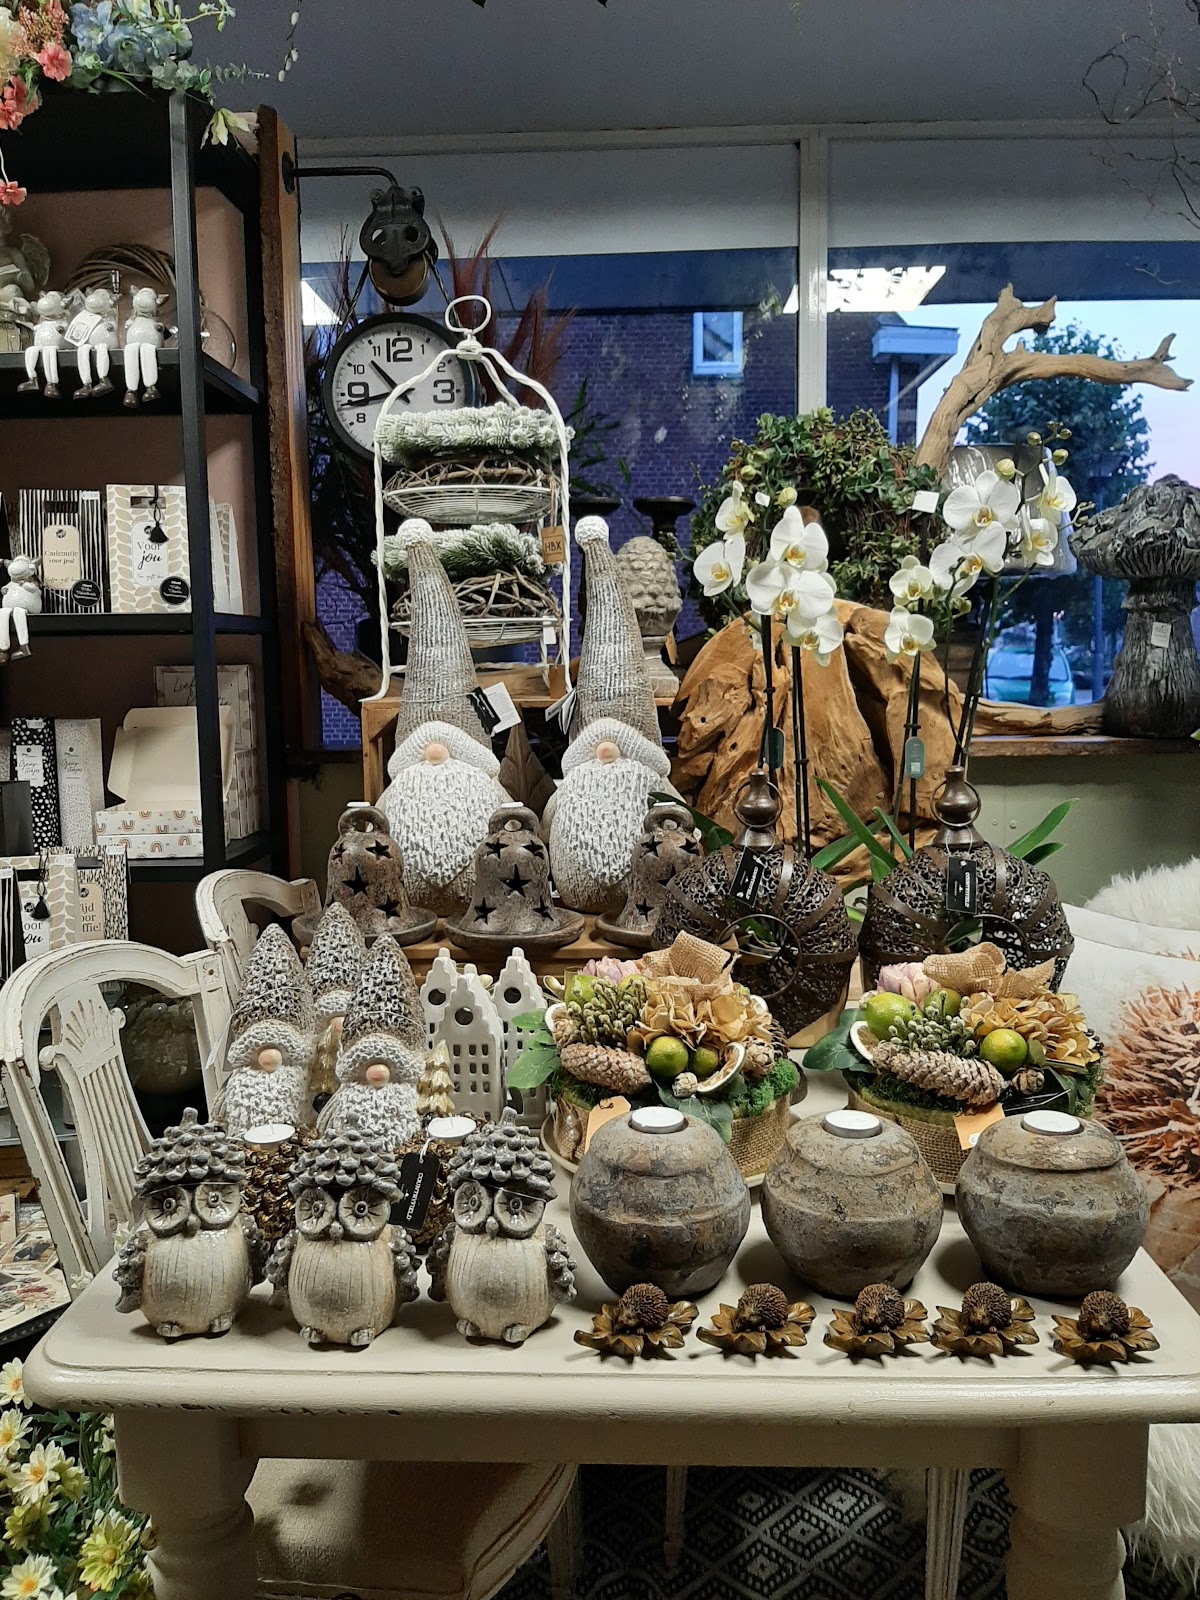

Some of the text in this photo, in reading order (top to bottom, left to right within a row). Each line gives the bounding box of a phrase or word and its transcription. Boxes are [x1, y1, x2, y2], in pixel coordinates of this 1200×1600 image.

[372, 345, 381, 357] 11
[386, 337, 413, 362] 12
[420, 344, 425, 355] 1
[353, 364, 365, 375] 10
[437, 362, 446, 373] 2
[347, 381, 370, 406] 9
[433, 379, 455, 404] 3
[356, 412, 366, 423] 8
[137, 541, 161, 551] Voor
[545, 541, 562, 552] HBX
[137, 551, 162, 571] jou
[80, 902, 94, 914] ijd
[24, 922, 44, 931] oor
[24, 933, 44, 945] ou
[406, 1172, 423, 1220] COUNTRYFIELD
